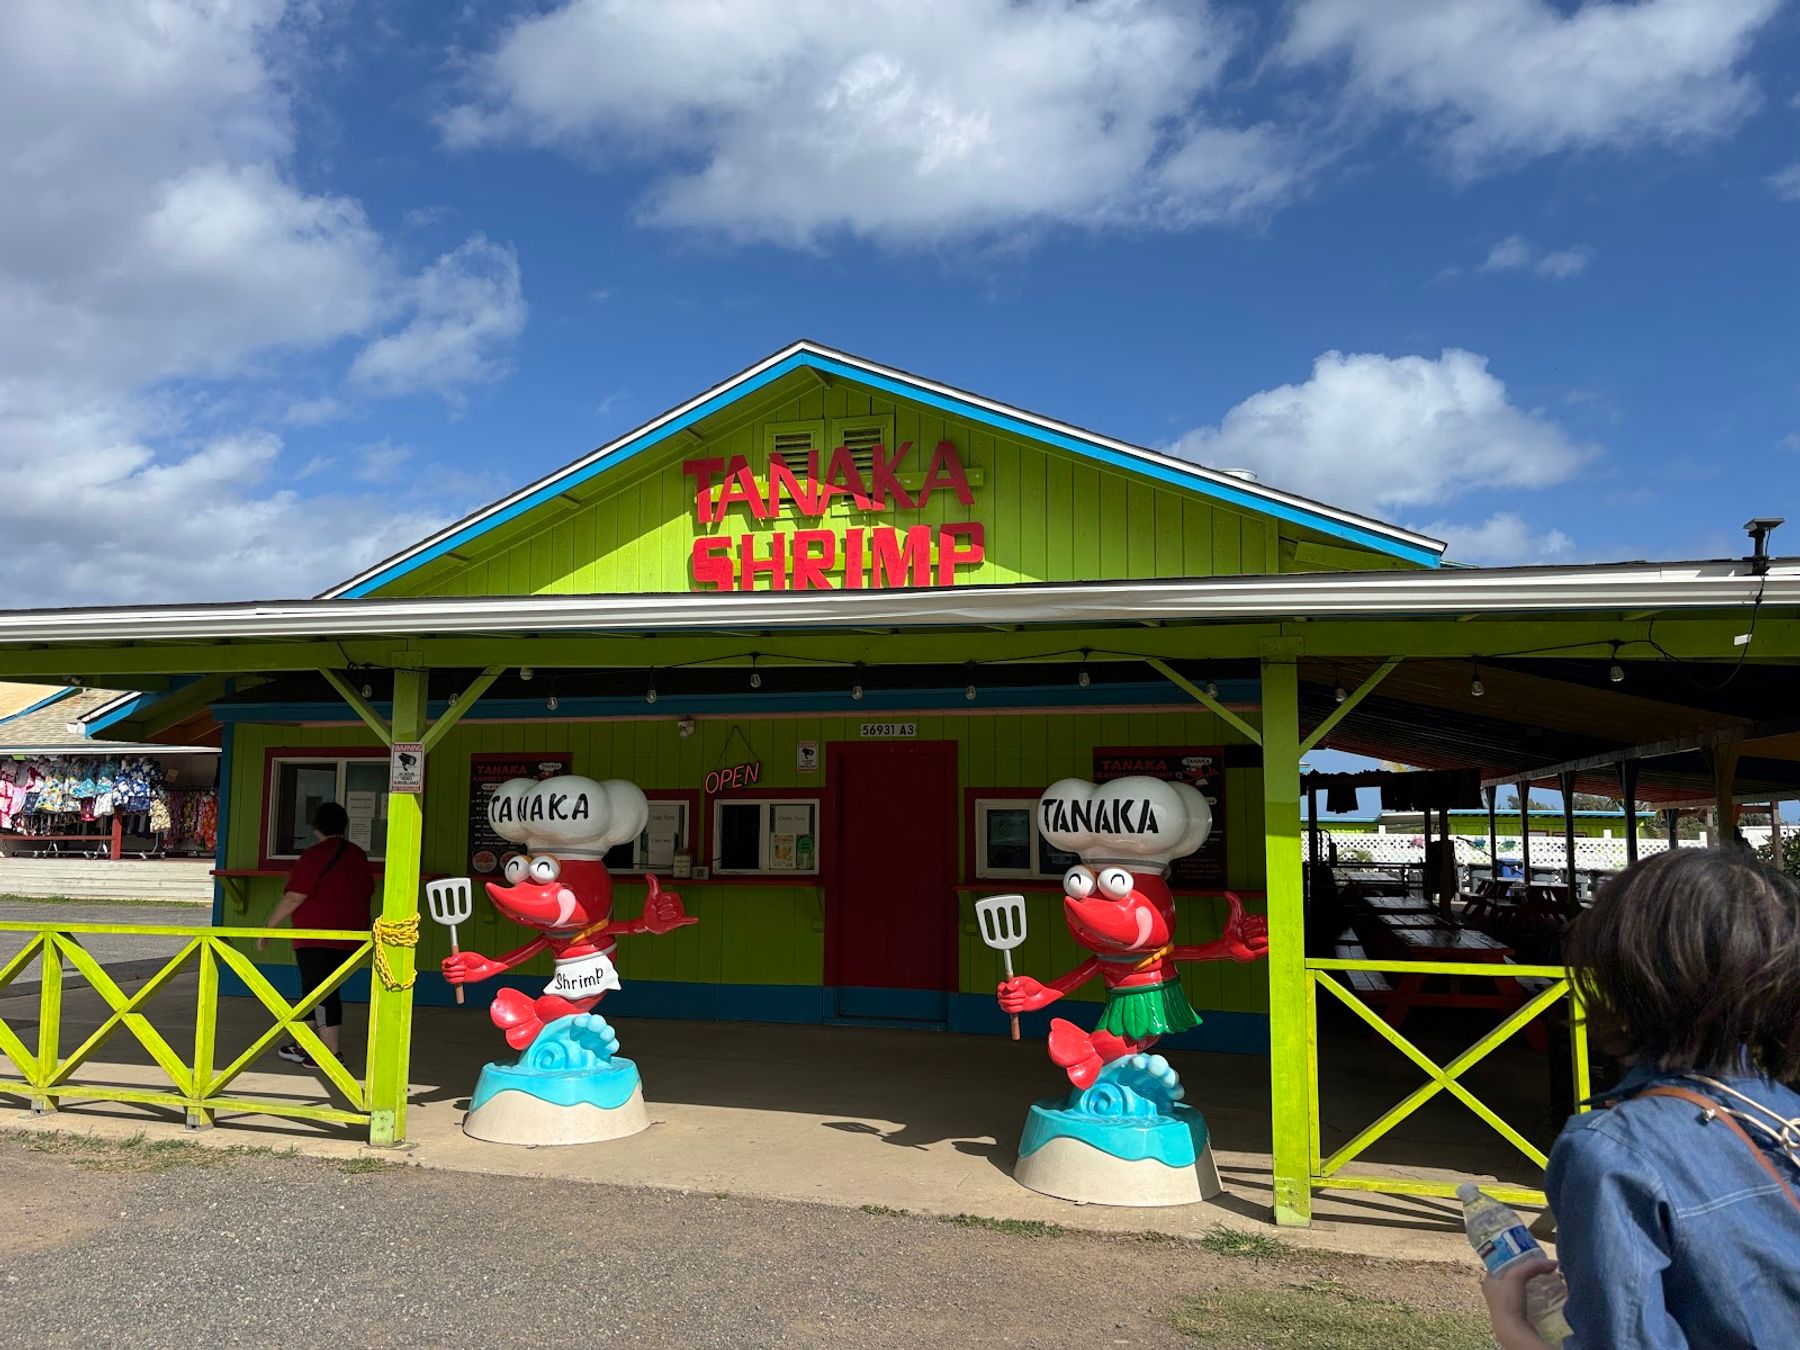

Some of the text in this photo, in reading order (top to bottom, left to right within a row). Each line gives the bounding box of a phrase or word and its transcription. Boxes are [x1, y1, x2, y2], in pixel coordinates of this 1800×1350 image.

[682, 440, 975, 524] TANAKA
[692, 522, 985, 592] SHRIMP
[862, 724, 914, 736] 56931 A3
[394, 744, 423, 752] WARNING
[476, 765, 527, 774] TANAKA
[705, 762, 760, 794] OPEN
[1101, 760, 1167, 770] TANAKA
[490, 793, 589, 823] TANAKA
[1041, 798, 1160, 834] TANAKA
[554, 967, 604, 990] Shrimp
